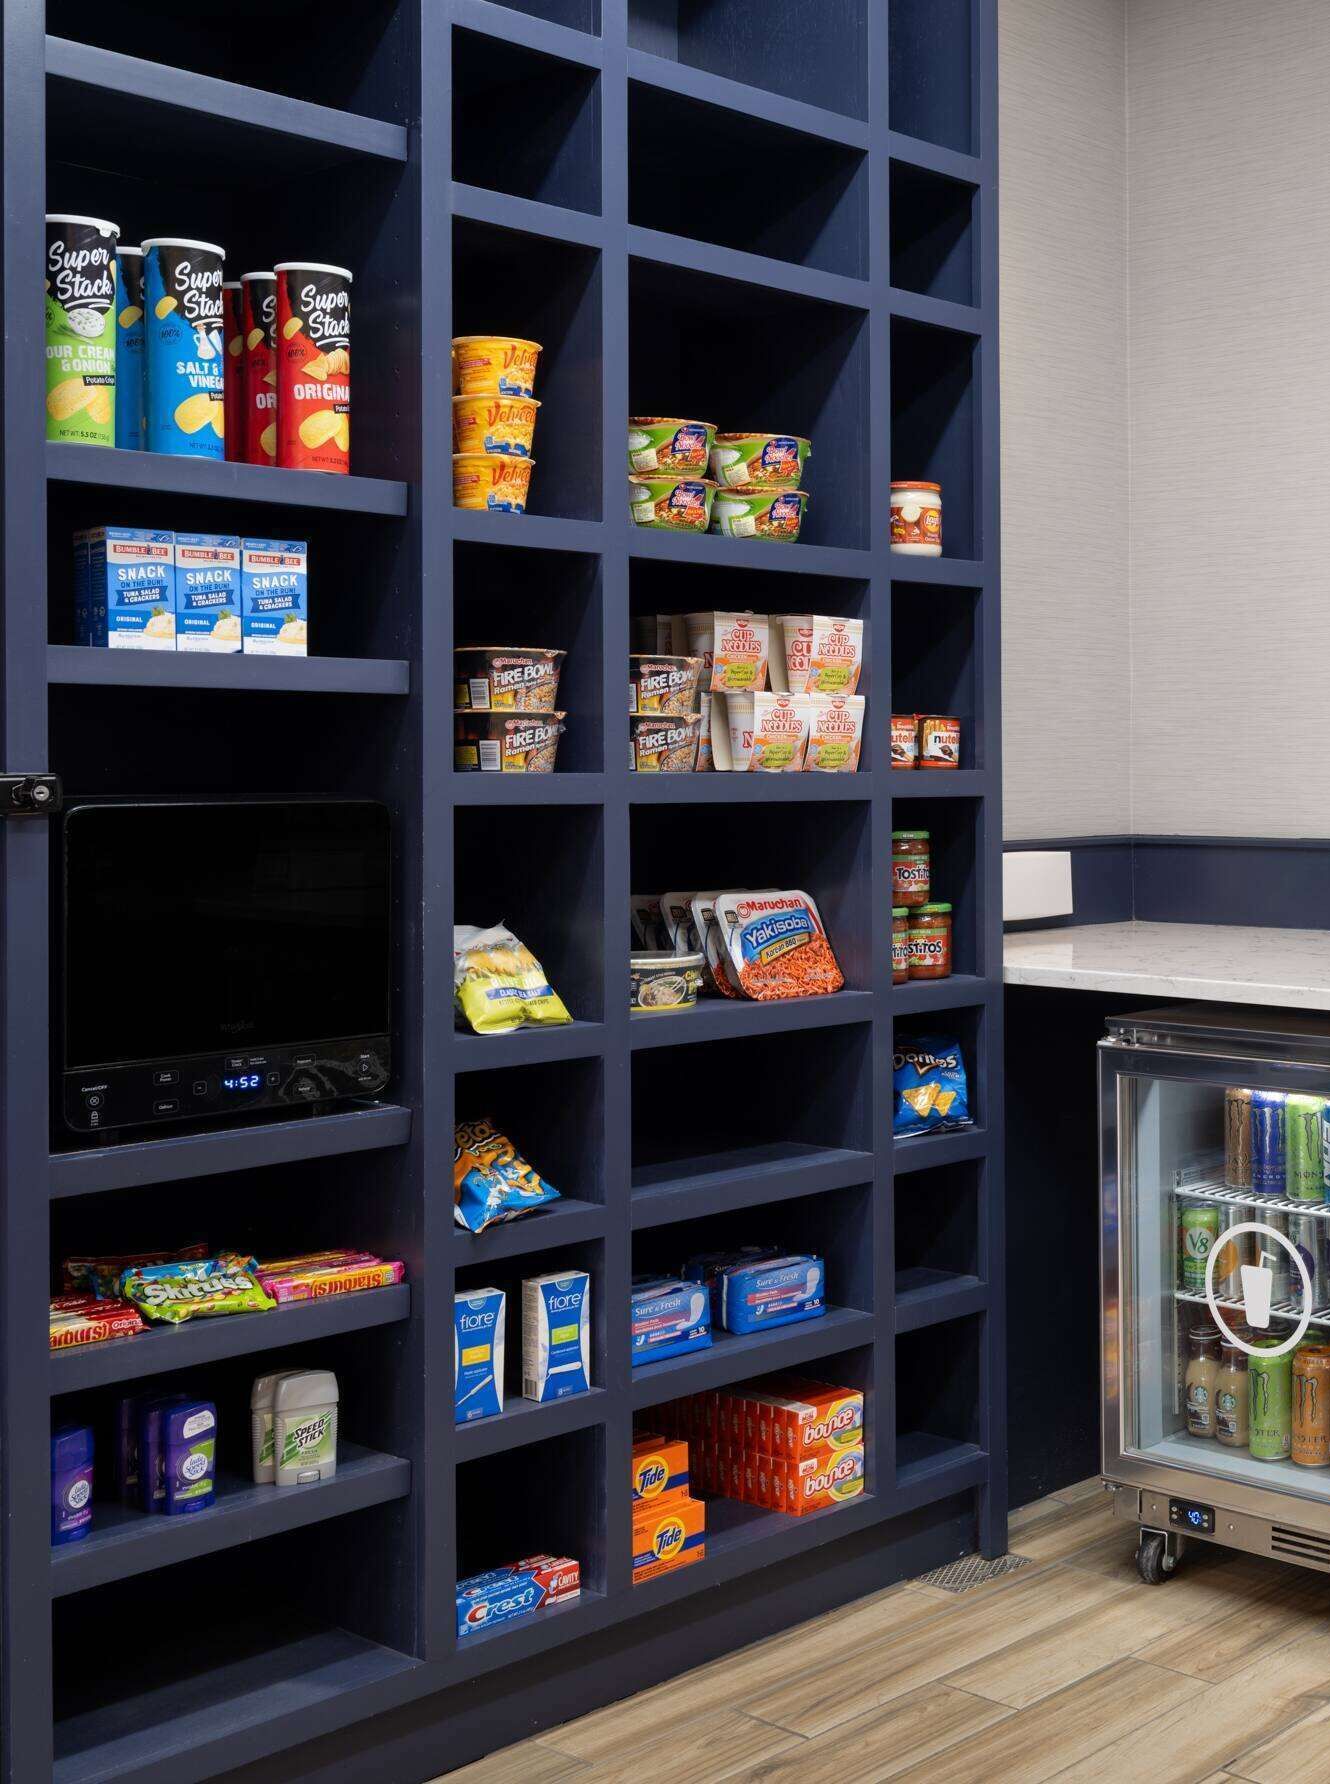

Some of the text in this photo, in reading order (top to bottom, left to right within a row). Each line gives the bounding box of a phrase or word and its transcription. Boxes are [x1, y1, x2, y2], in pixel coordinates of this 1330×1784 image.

[49, 240, 109, 271] Super
[56, 268, 112, 299] Stack
[174, 261, 223, 291] Super
[301, 284, 348, 314] Super
[46, 345, 72, 358] OUR
[72, 361, 112, 373] ONION
[176, 361, 209, 374] SALT
[152, 548, 166, 556] BEE
[251, 555, 297, 565] BUMBLE BEE
[118, 566, 166, 580] SNACK
[186, 570, 232, 585] SNACK
[252, 575, 298, 589] SNACK
[130, 594, 160, 603] CRACKERS
[198, 598, 227, 606] CRACKERS
[264, 602, 293, 610] CRACKERS
[732, 629, 754, 640] CUP
[828, 633, 849, 645] CUP
[721, 639, 761, 653] NOODLES
[792, 640, 813, 656] CU
[818, 643, 855, 657] NOODLES
[493, 668, 522, 686] FIRE
[641, 674, 667, 691] FIRE
[771, 709, 795, 721] CUP
[827, 710, 850, 722] CUP
[761, 720, 802, 733] NOODLES
[816, 720, 856, 733] NOODLES
[505, 730, 533, 749] FIRE
[640, 731, 665, 748] FIRE
[746, 898, 801, 913] Maruchan
[745, 916, 809, 948] Yakisoba
[786, 938, 796, 949] BBQ
[224, 1075, 259, 1089] 4:52
[1189, 1233, 1209, 1253] V8
[549, 1292, 583, 1310] fiore
[460, 1311, 495, 1329] fiore
[294, 1418, 325, 1440] SPEED
[804, 1408, 854, 1446] bounce
[297, 1427, 325, 1448] STICK
[638, 1462, 666, 1494] Tide
[804, 1459, 855, 1498] bounce
[655, 1524, 683, 1556] Tide
[558, 1570, 579, 1587] CAVITY
[466, 1587, 535, 1625] Crest
